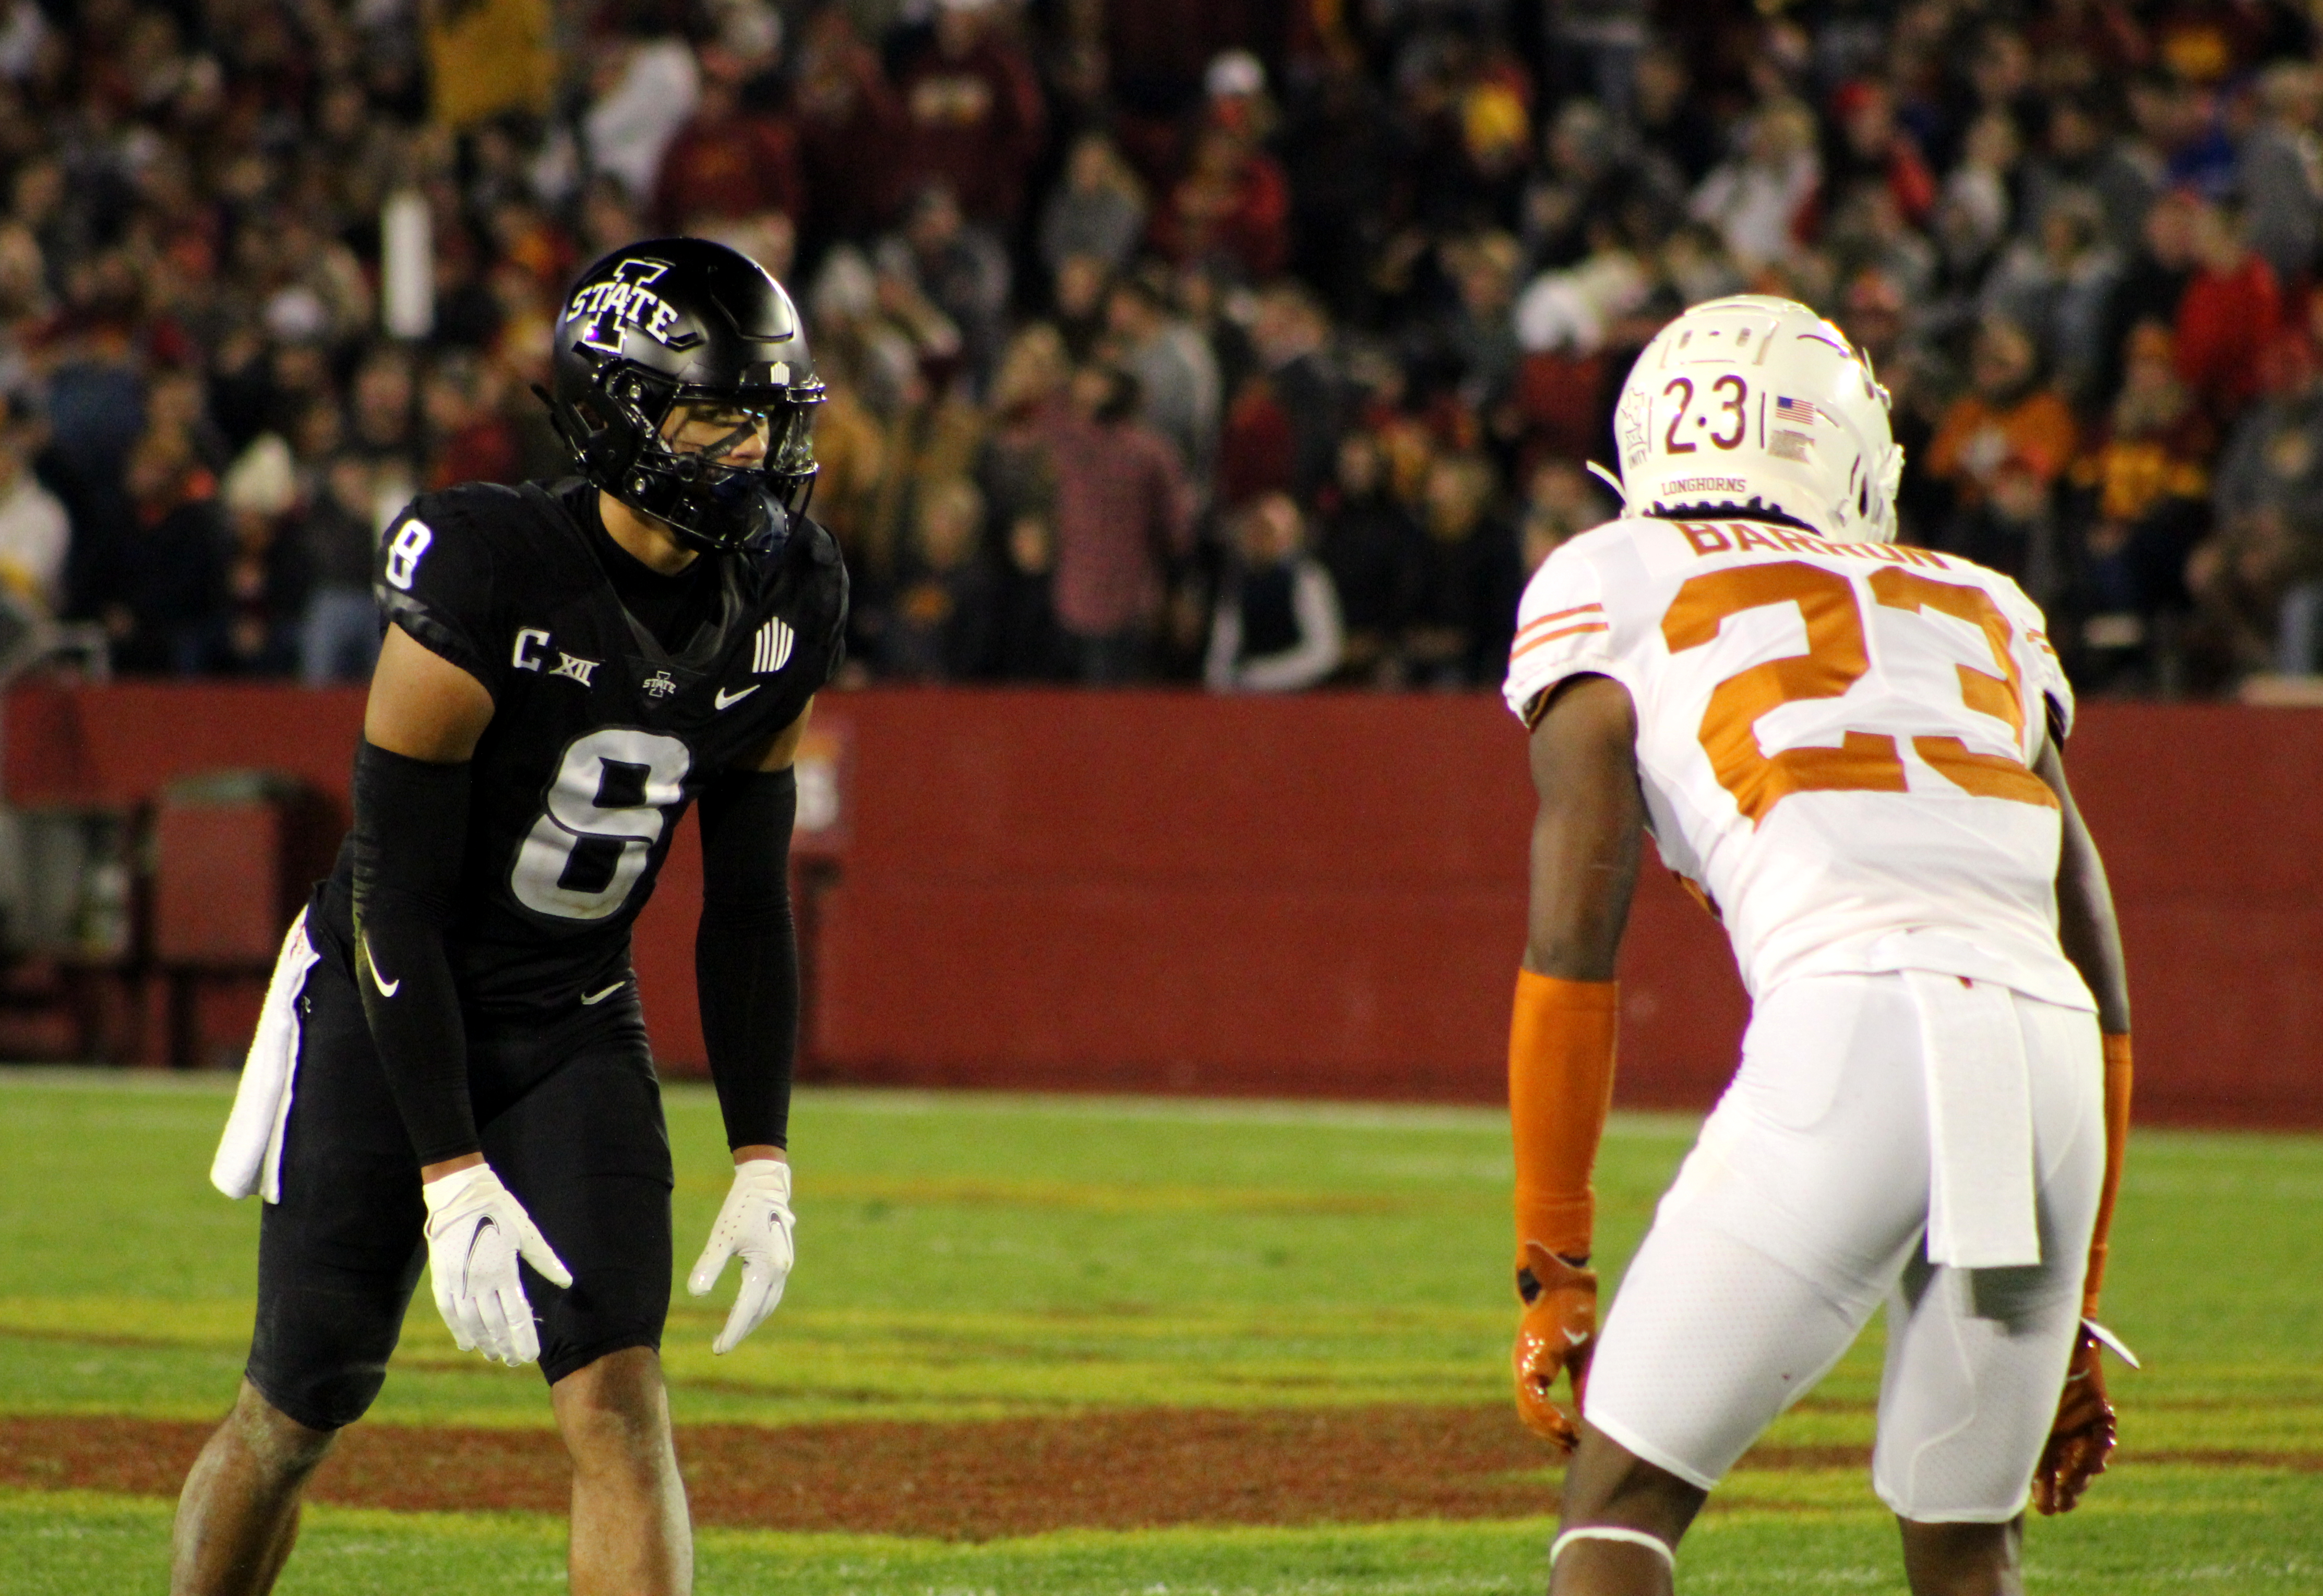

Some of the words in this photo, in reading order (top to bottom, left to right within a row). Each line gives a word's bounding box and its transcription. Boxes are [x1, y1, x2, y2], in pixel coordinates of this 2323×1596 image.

[566, 280, 678, 344] STATE
[1663, 374, 1748, 455] 23
[1661, 477, 1747, 496] LONGHORNS
[385, 518, 433, 590] 8
[512, 628, 550, 671] C
[642, 678, 677, 694] STATE
[1660, 559, 2063, 835] 23
[511, 729, 690, 920] 8
